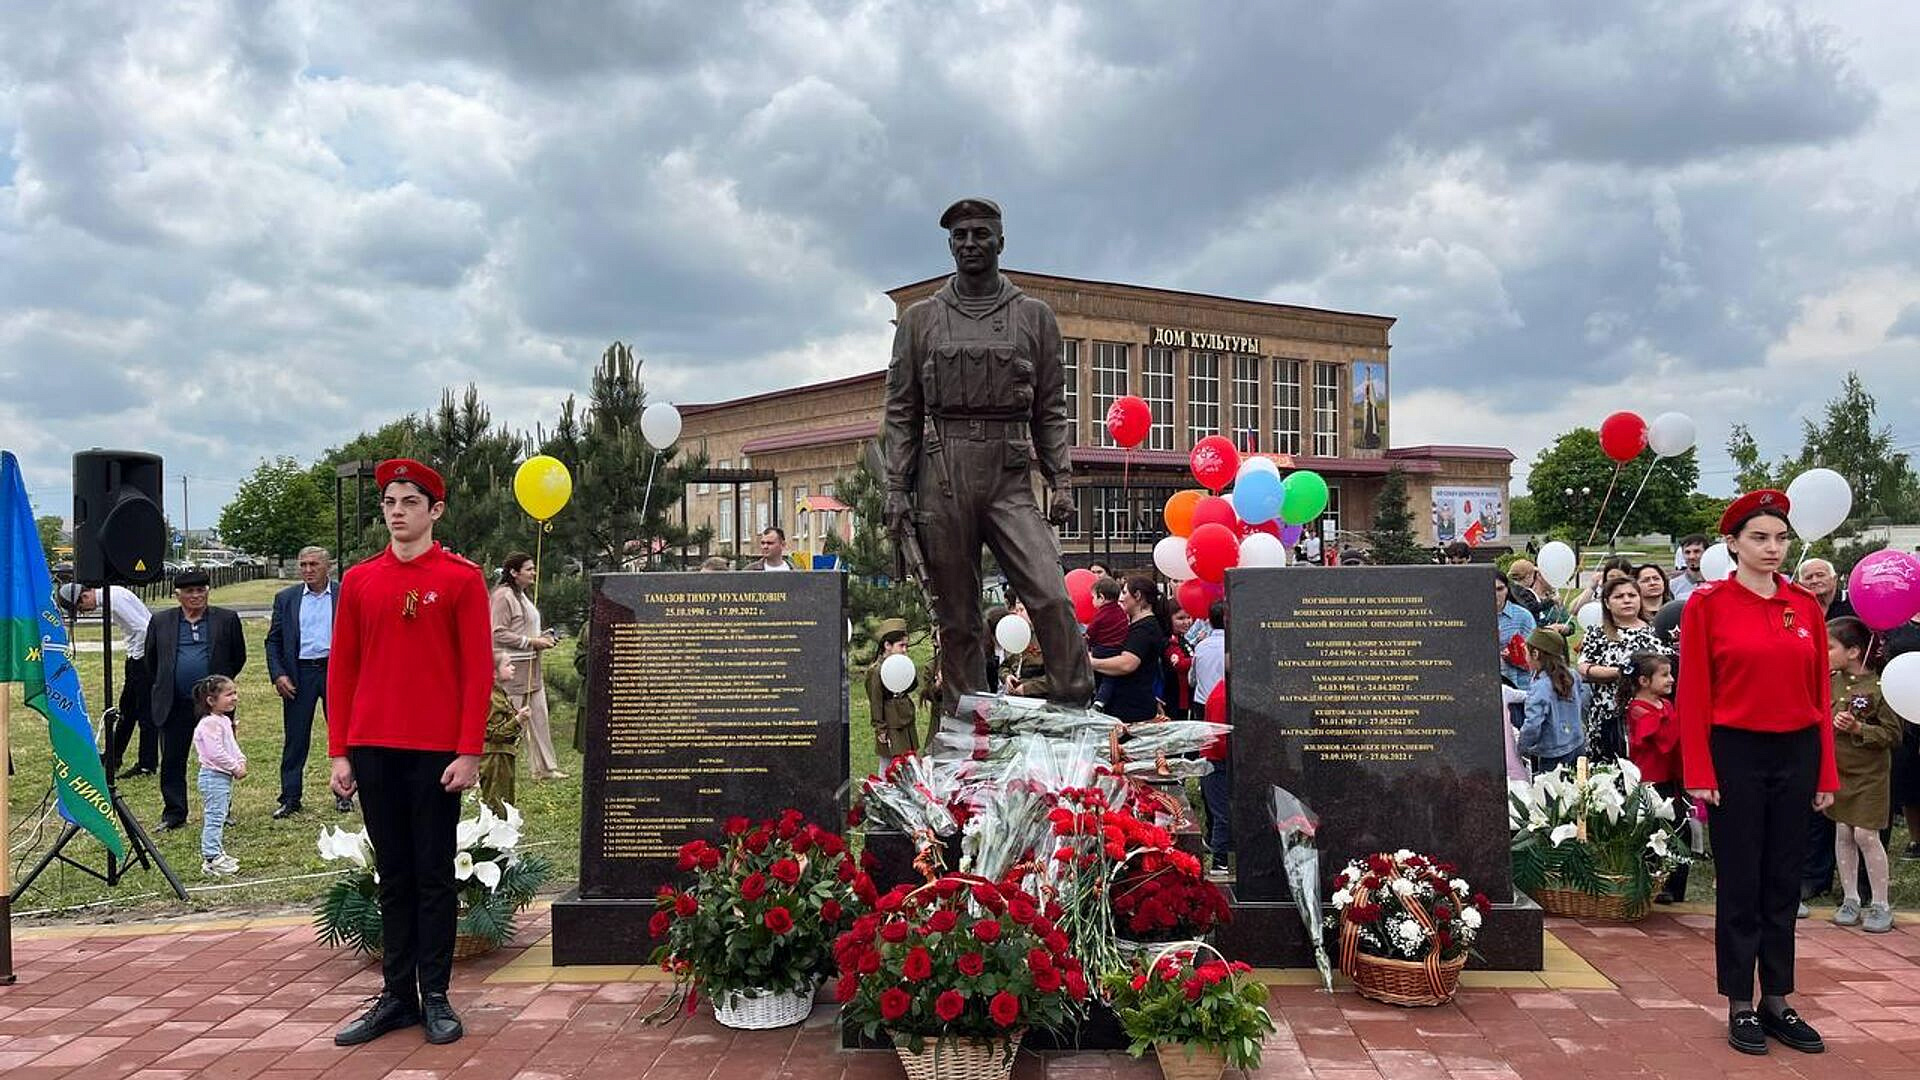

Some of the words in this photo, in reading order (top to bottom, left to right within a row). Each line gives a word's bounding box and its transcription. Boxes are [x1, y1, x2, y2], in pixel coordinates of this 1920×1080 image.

[1154, 327, 1185, 346] ДОМ
[1190, 331, 1259, 354] КУЛЬТУРЫ
[644, 593, 685, 603] ТАМАЗОВ
[686, 592, 717, 603] ТИМУР
[718, 592, 788, 602] МУХАМЕДОВИЧ
